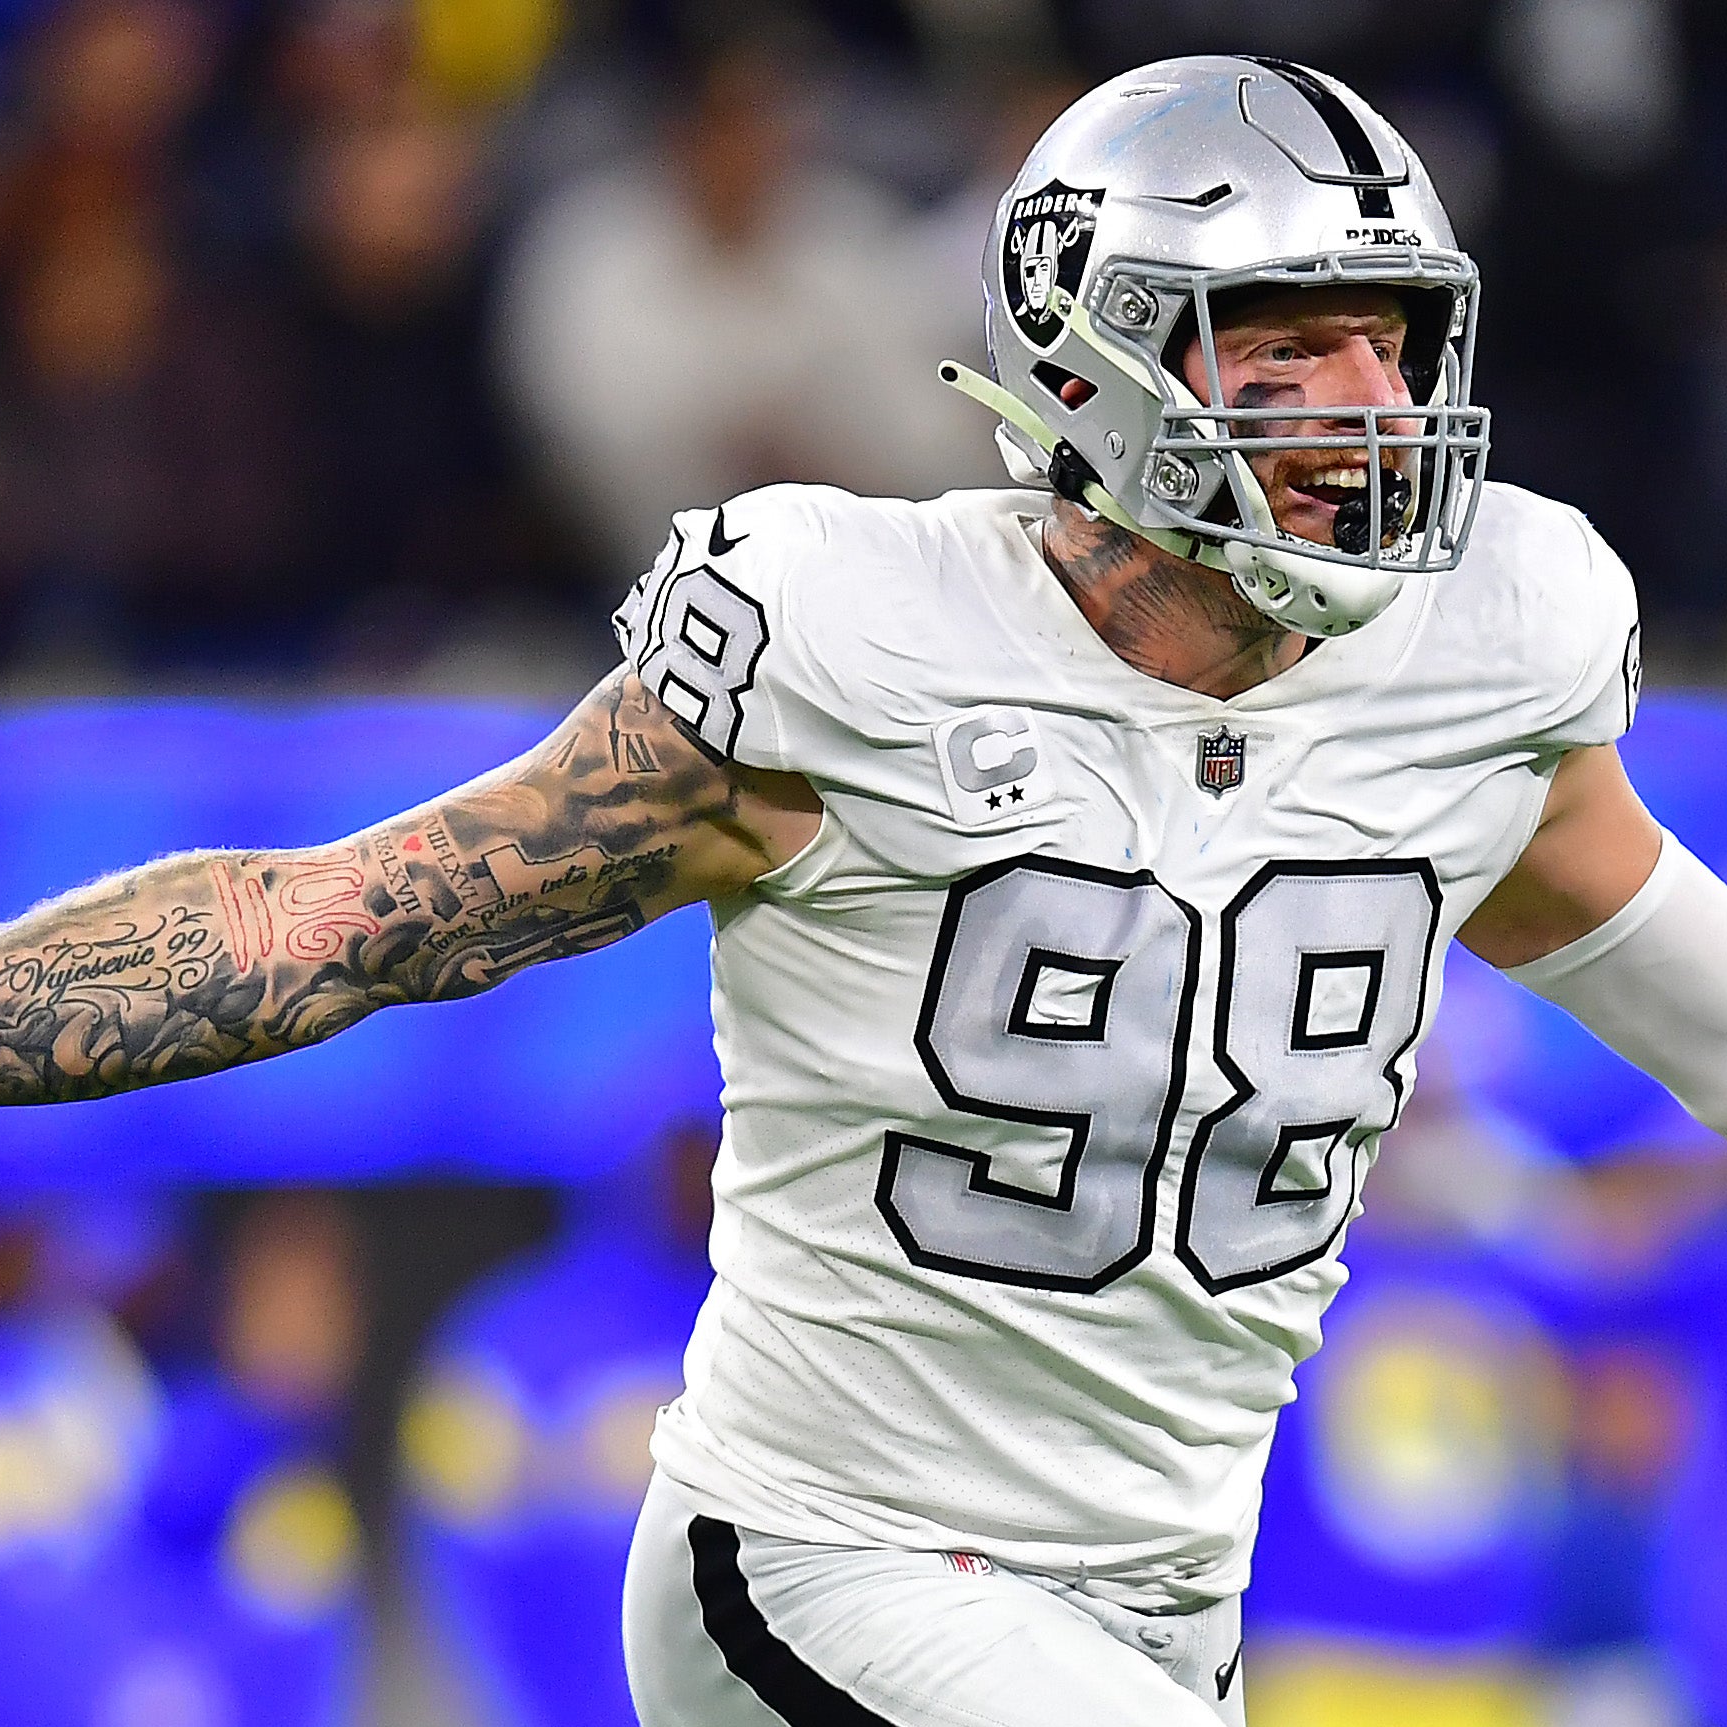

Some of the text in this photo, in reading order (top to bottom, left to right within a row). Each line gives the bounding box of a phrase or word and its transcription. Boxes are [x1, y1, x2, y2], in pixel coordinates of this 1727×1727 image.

[1014, 192, 1096, 220] RAIDERS
[946, 708, 1038, 794] C
[1205, 759, 1239, 785] NFL
[167, 927, 209, 960] 99
[874, 853, 1444, 1298] 98
[952, 1553, 990, 1575] NFL
